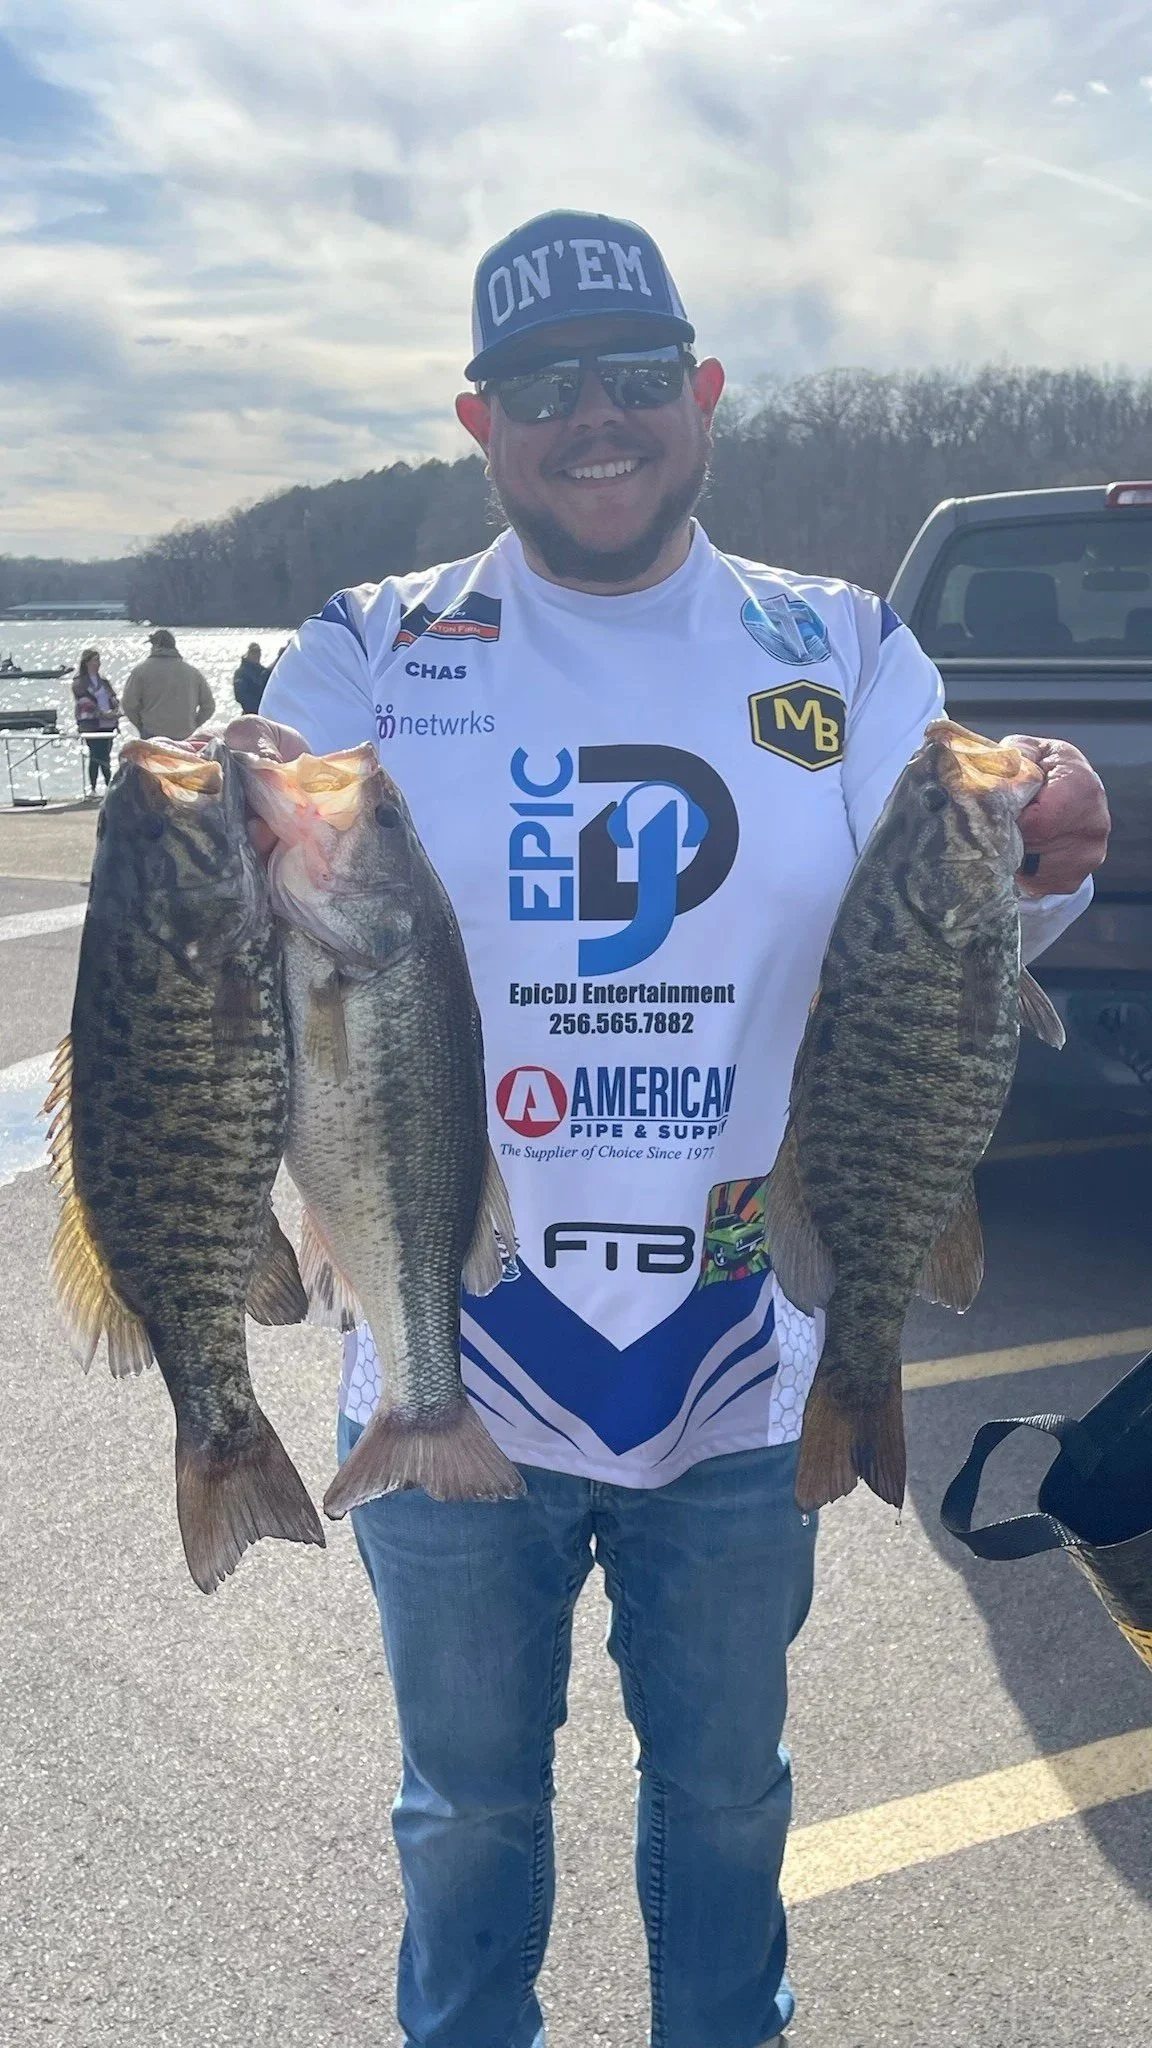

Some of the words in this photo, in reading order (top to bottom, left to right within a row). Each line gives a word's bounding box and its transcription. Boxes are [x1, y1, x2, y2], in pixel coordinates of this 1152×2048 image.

[488, 238, 652, 326] ON'EM
[405, 661, 467, 680] CHAS
[400, 710, 495, 736] netwrks
[774, 698, 839, 752] MB
[509, 747, 574, 921] EPIC
[510, 983, 577, 1006] EpicDJ
[583, 982, 735, 1004] Entertainment
[549, 1012, 694, 1034] 256.565.7882
[570, 1124, 623, 1138] PIPE
[634, 1125, 647, 1139] &
[500, 1143, 521, 1157] The
[523, 1145, 578, 1162] Supplier
[581, 1144, 594, 1160] of
[598, 1145, 644, 1159] Choice
[646, 1146, 682, 1160] Since
